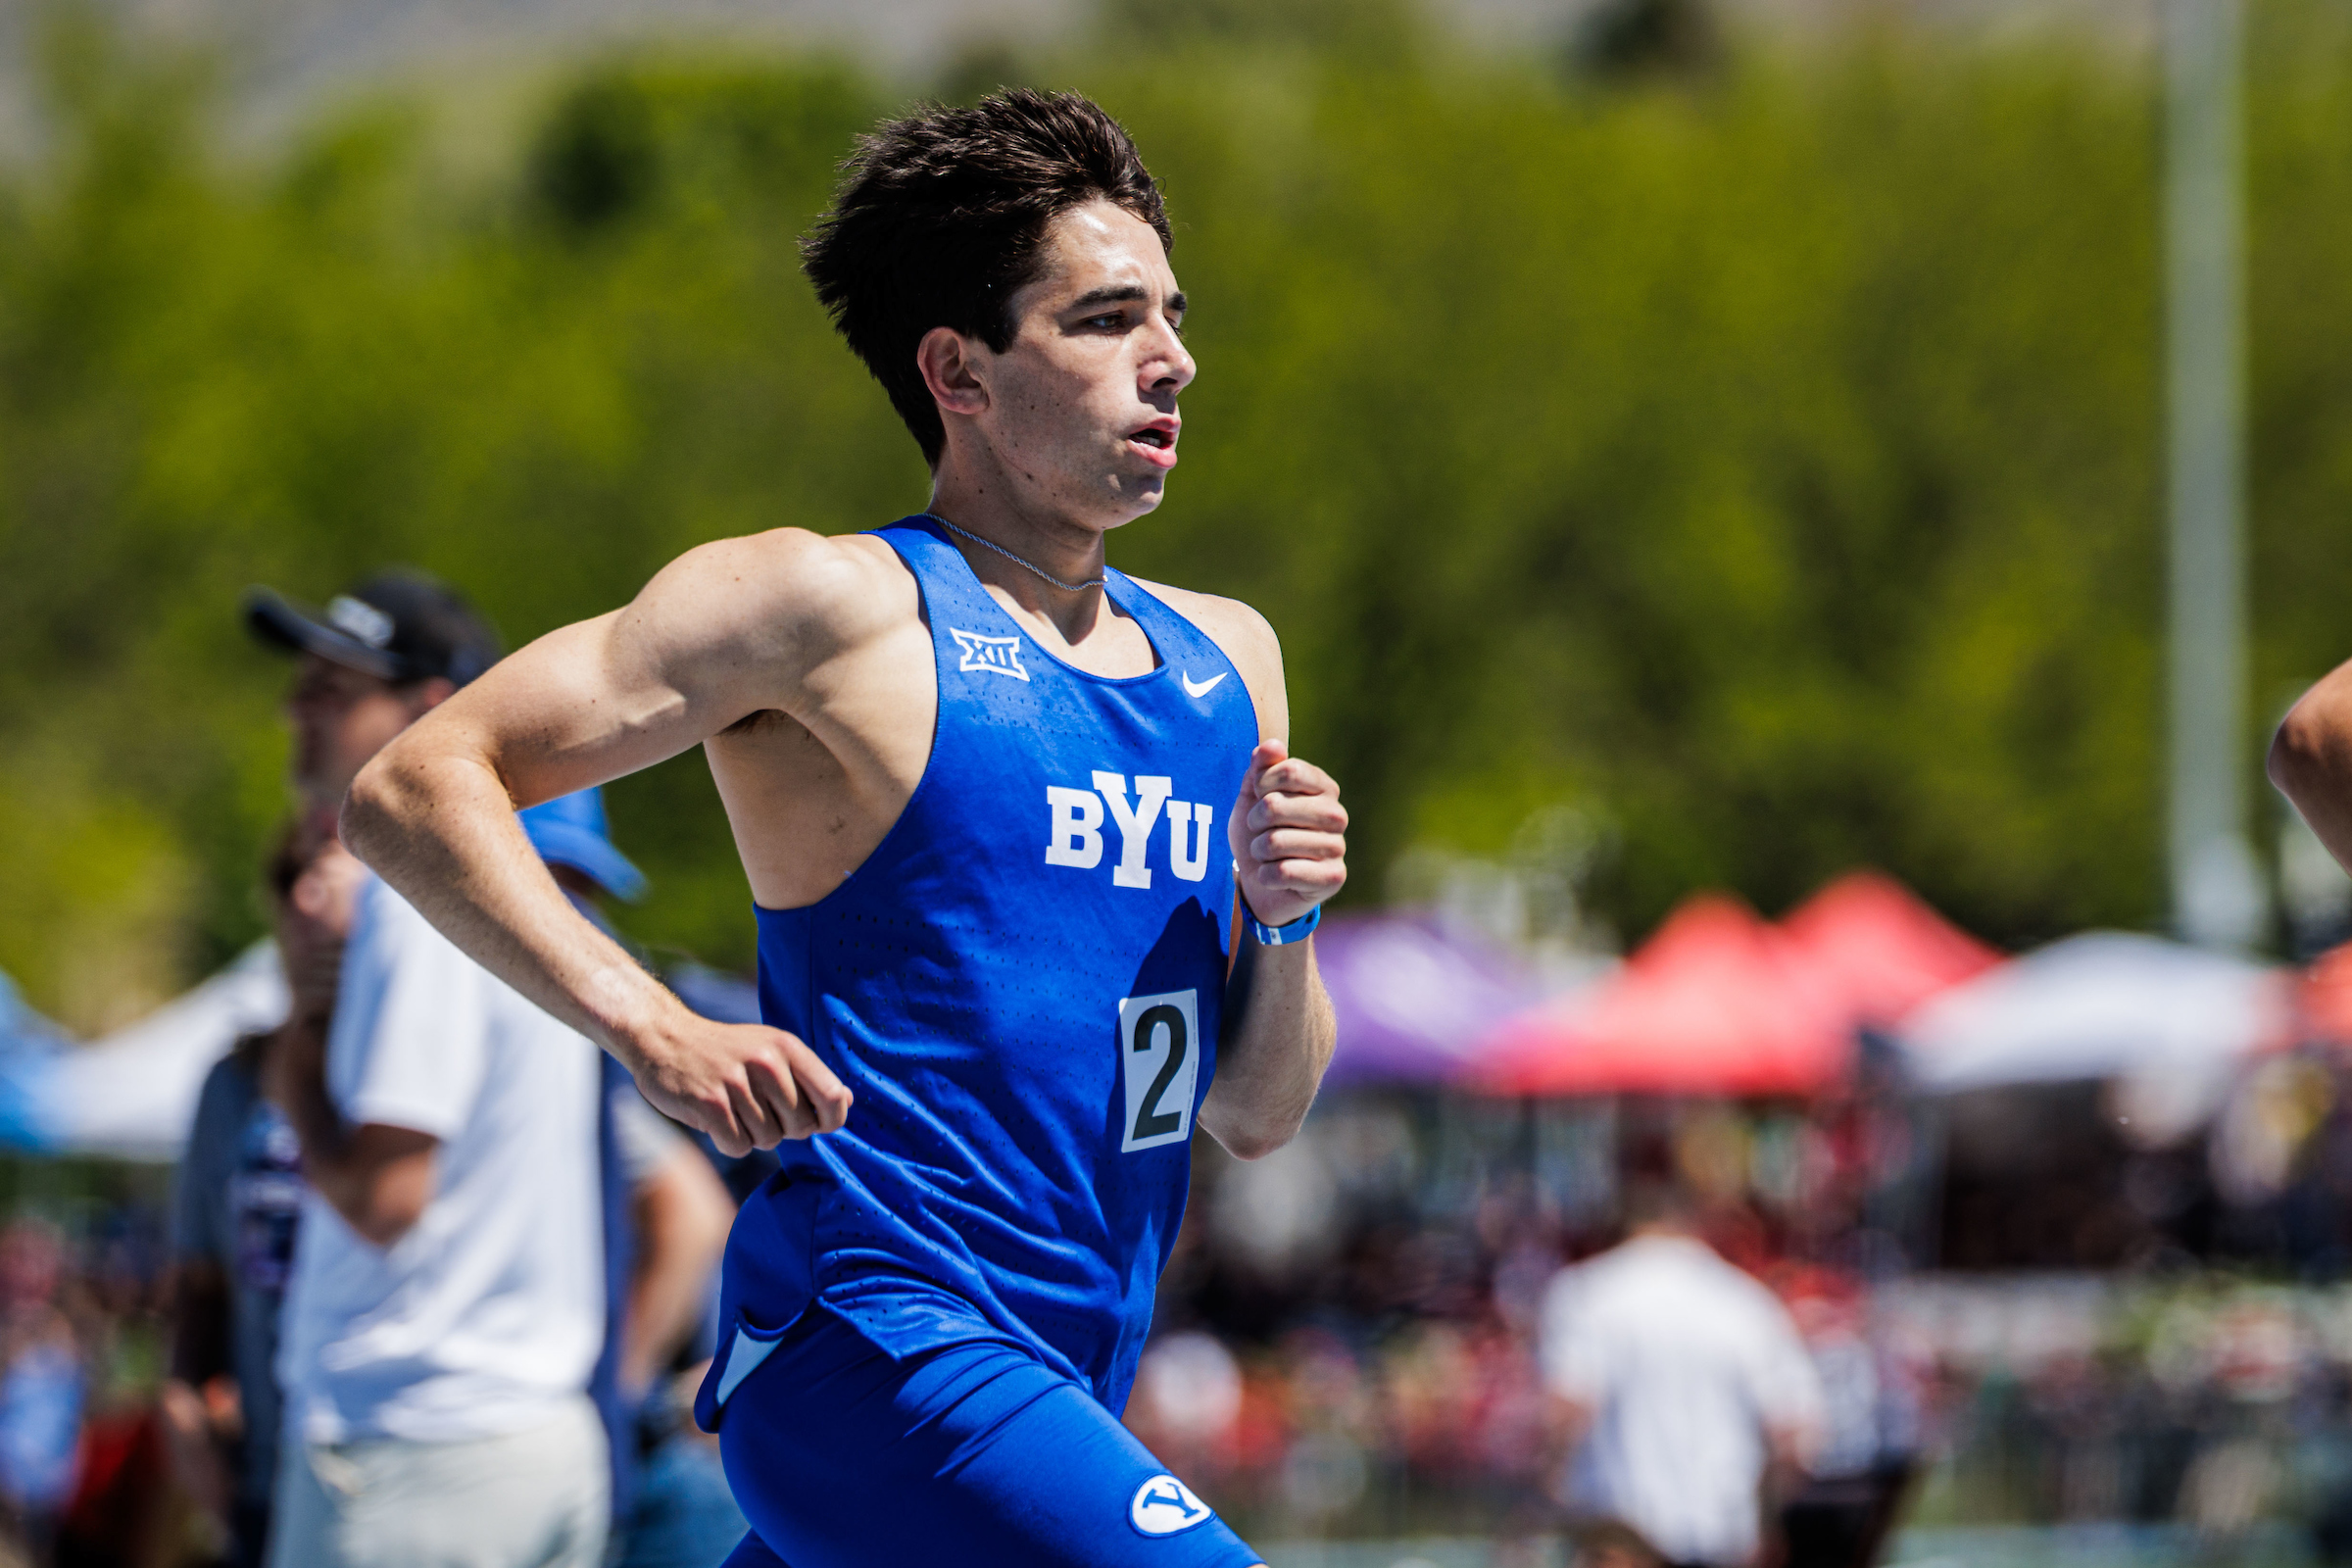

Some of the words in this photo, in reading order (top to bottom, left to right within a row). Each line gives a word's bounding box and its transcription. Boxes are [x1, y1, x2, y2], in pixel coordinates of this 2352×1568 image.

[1046, 769, 1213, 890] BYU
[1132, 1004, 1188, 1142] 2
[1142, 1482, 1201, 1520] Y
